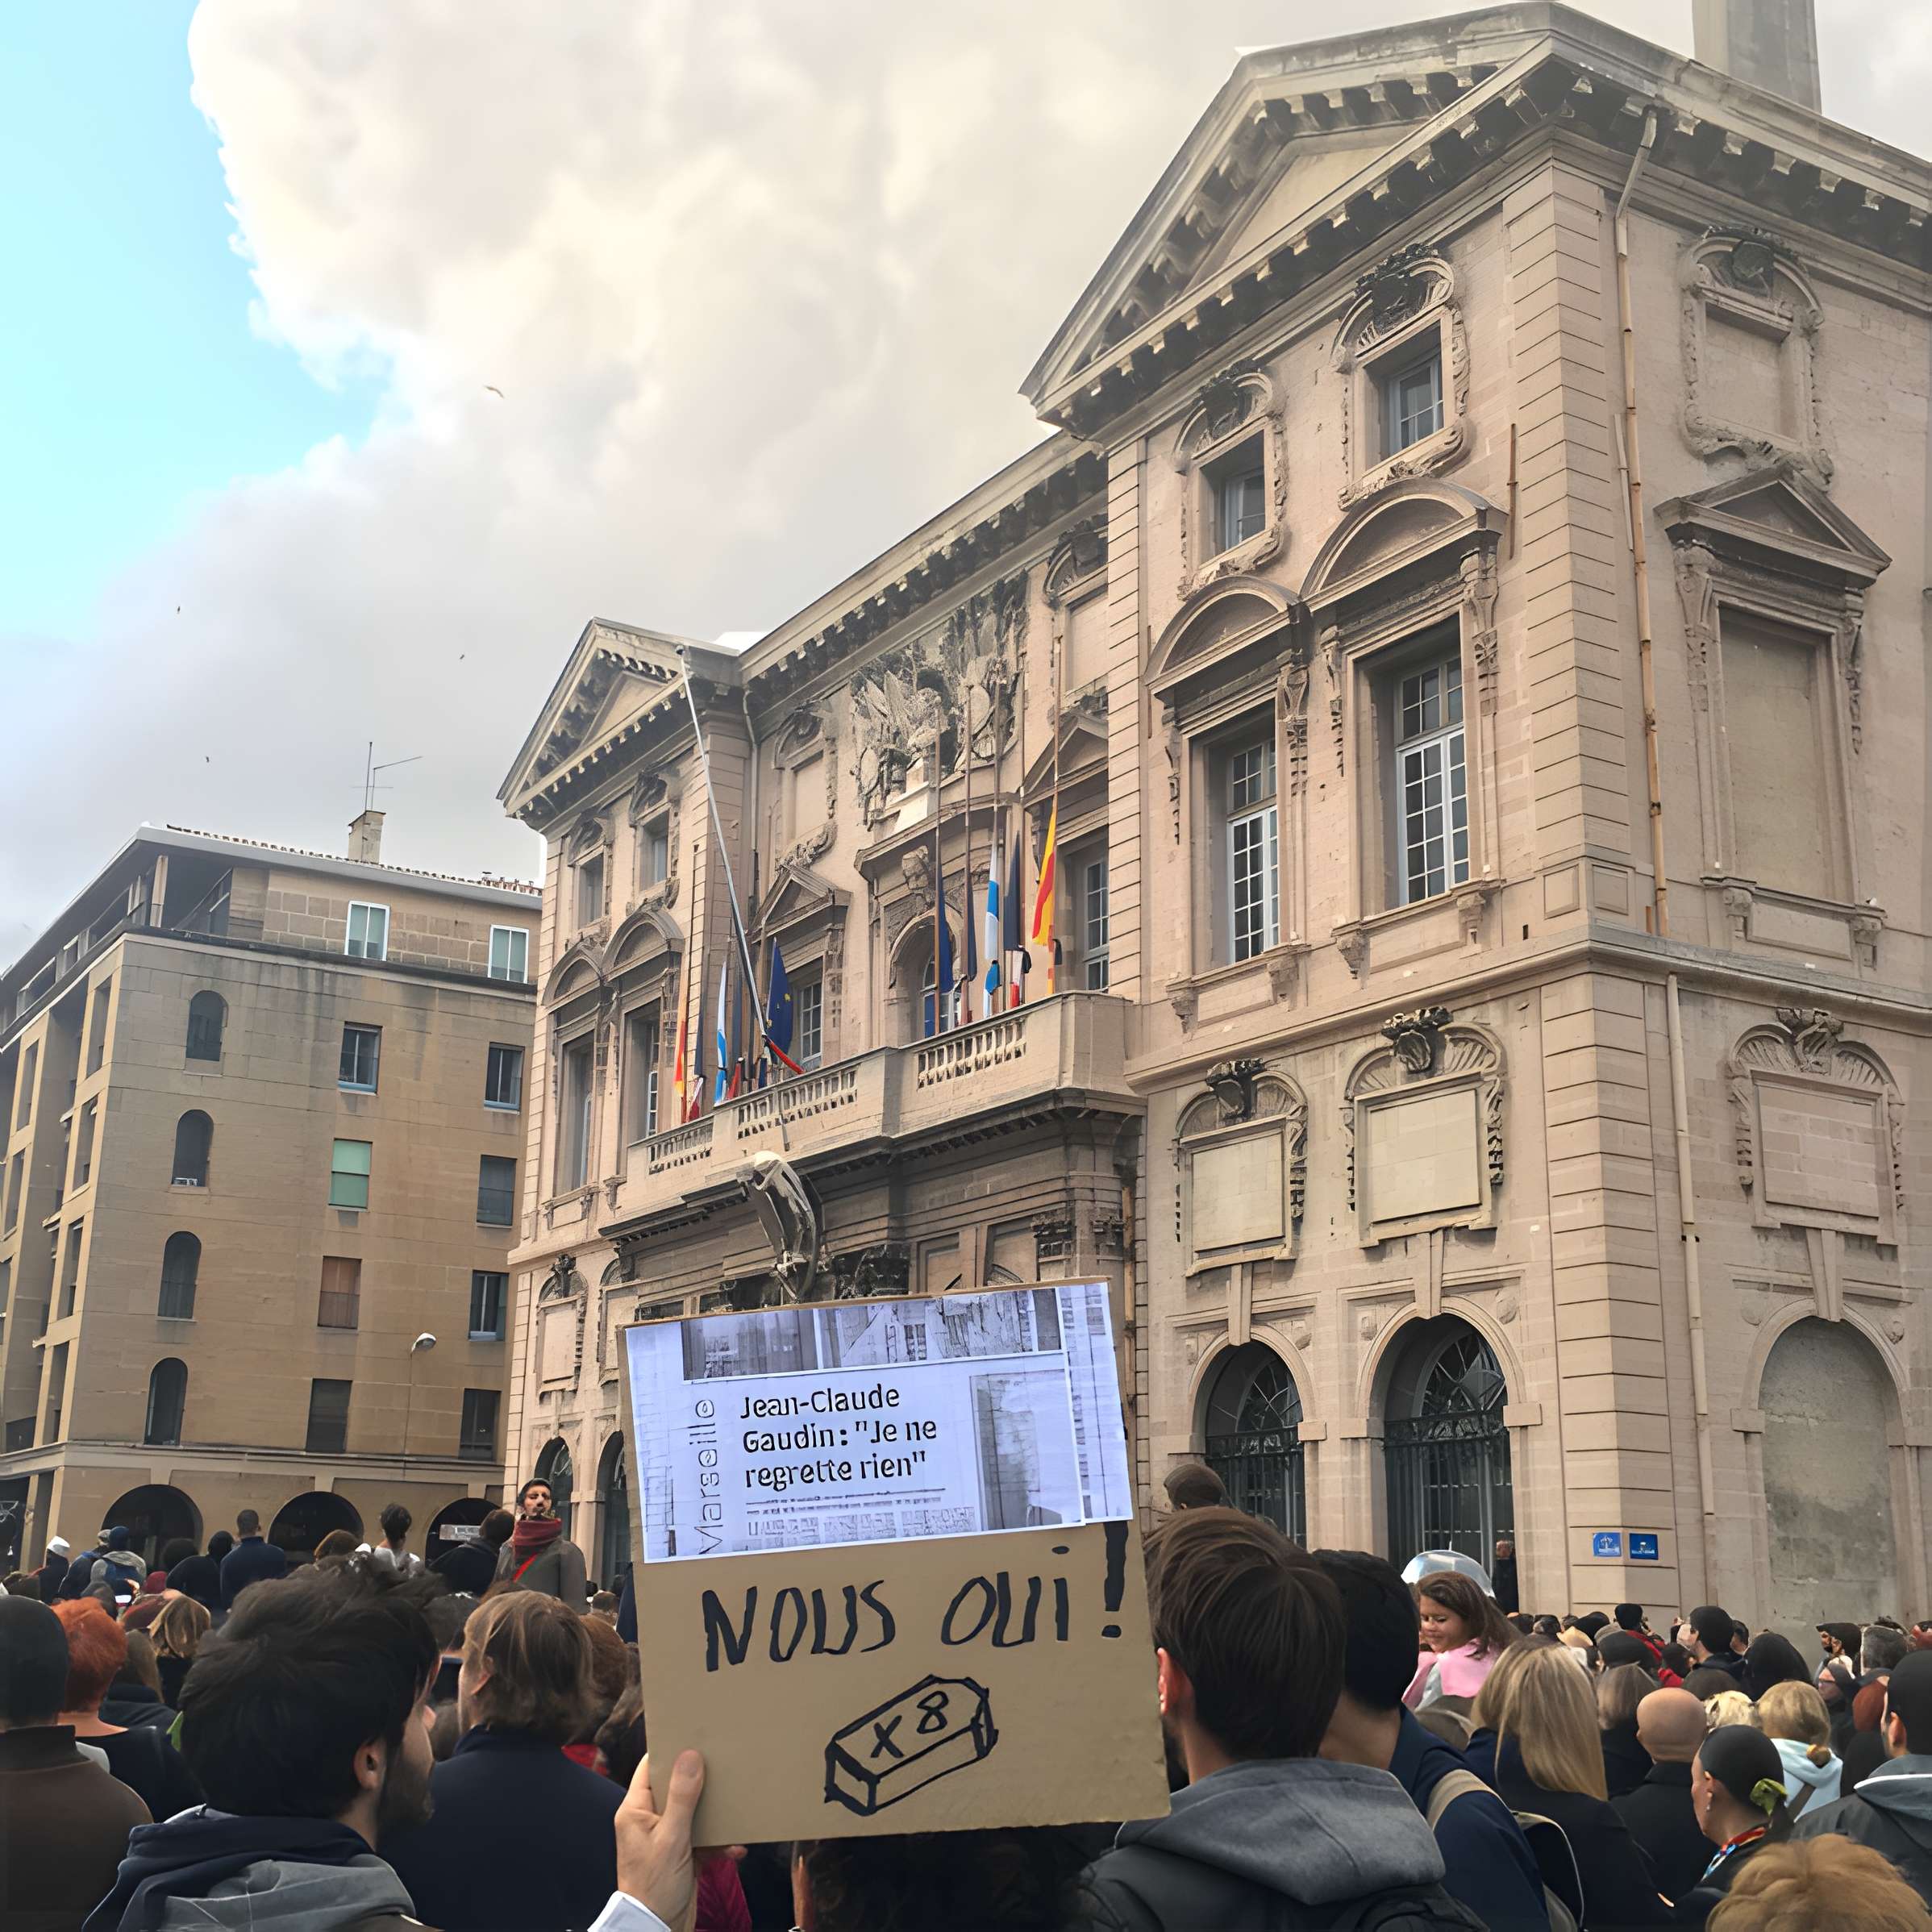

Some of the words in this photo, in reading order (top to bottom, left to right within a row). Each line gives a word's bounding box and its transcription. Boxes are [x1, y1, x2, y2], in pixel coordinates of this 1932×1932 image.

[739, 1383, 900, 1419] Jean-Claude
[855, 1420, 897, 1444] "Je
[906, 1420, 937, 1441] ne
[744, 1459, 852, 1492] regrette
[860, 1450, 926, 1479] rien"
[701, 1579, 897, 1672] NOUS
